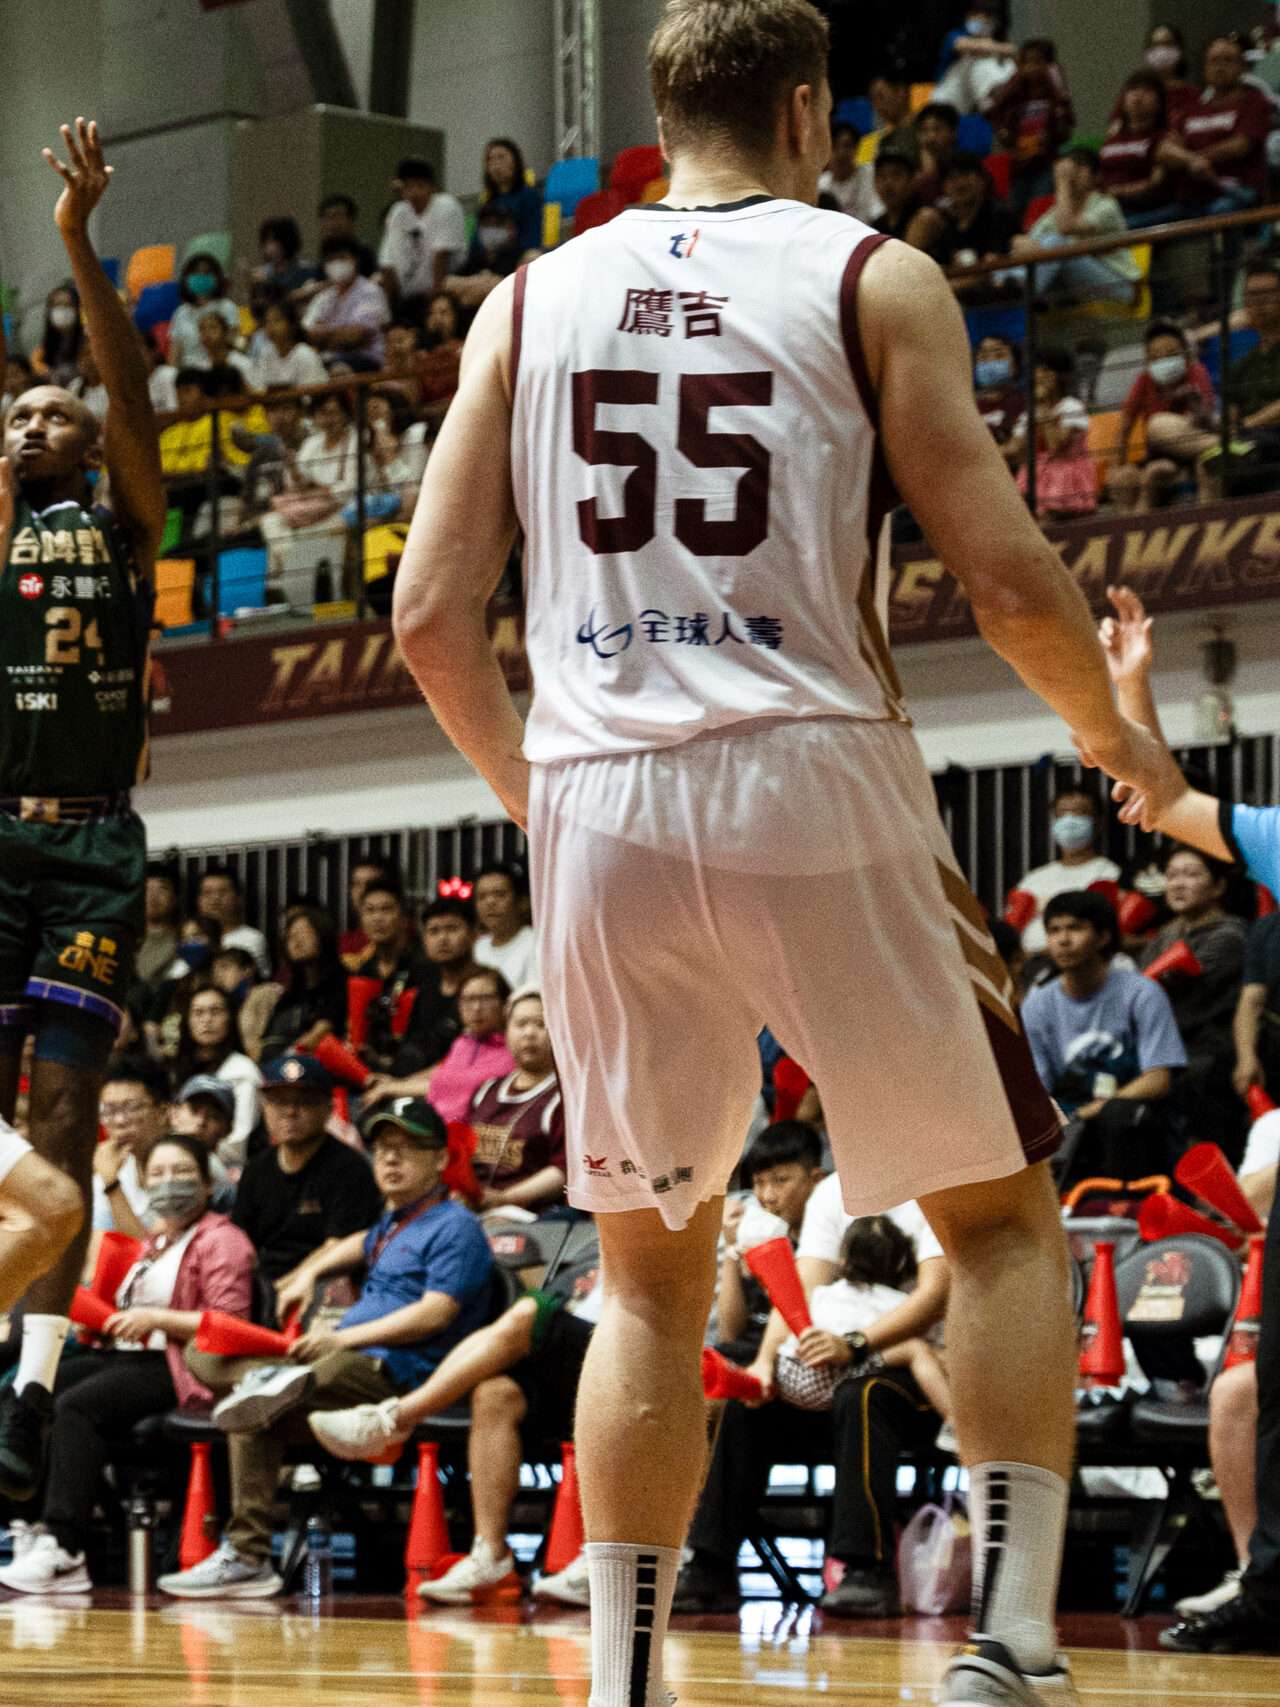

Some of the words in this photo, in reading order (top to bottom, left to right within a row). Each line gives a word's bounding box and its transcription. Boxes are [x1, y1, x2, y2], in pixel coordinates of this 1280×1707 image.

[616, 287, 729, 339] 鷹吉
[571, 368, 774, 557] 55
[638, 608, 785, 651] 全球人壽
